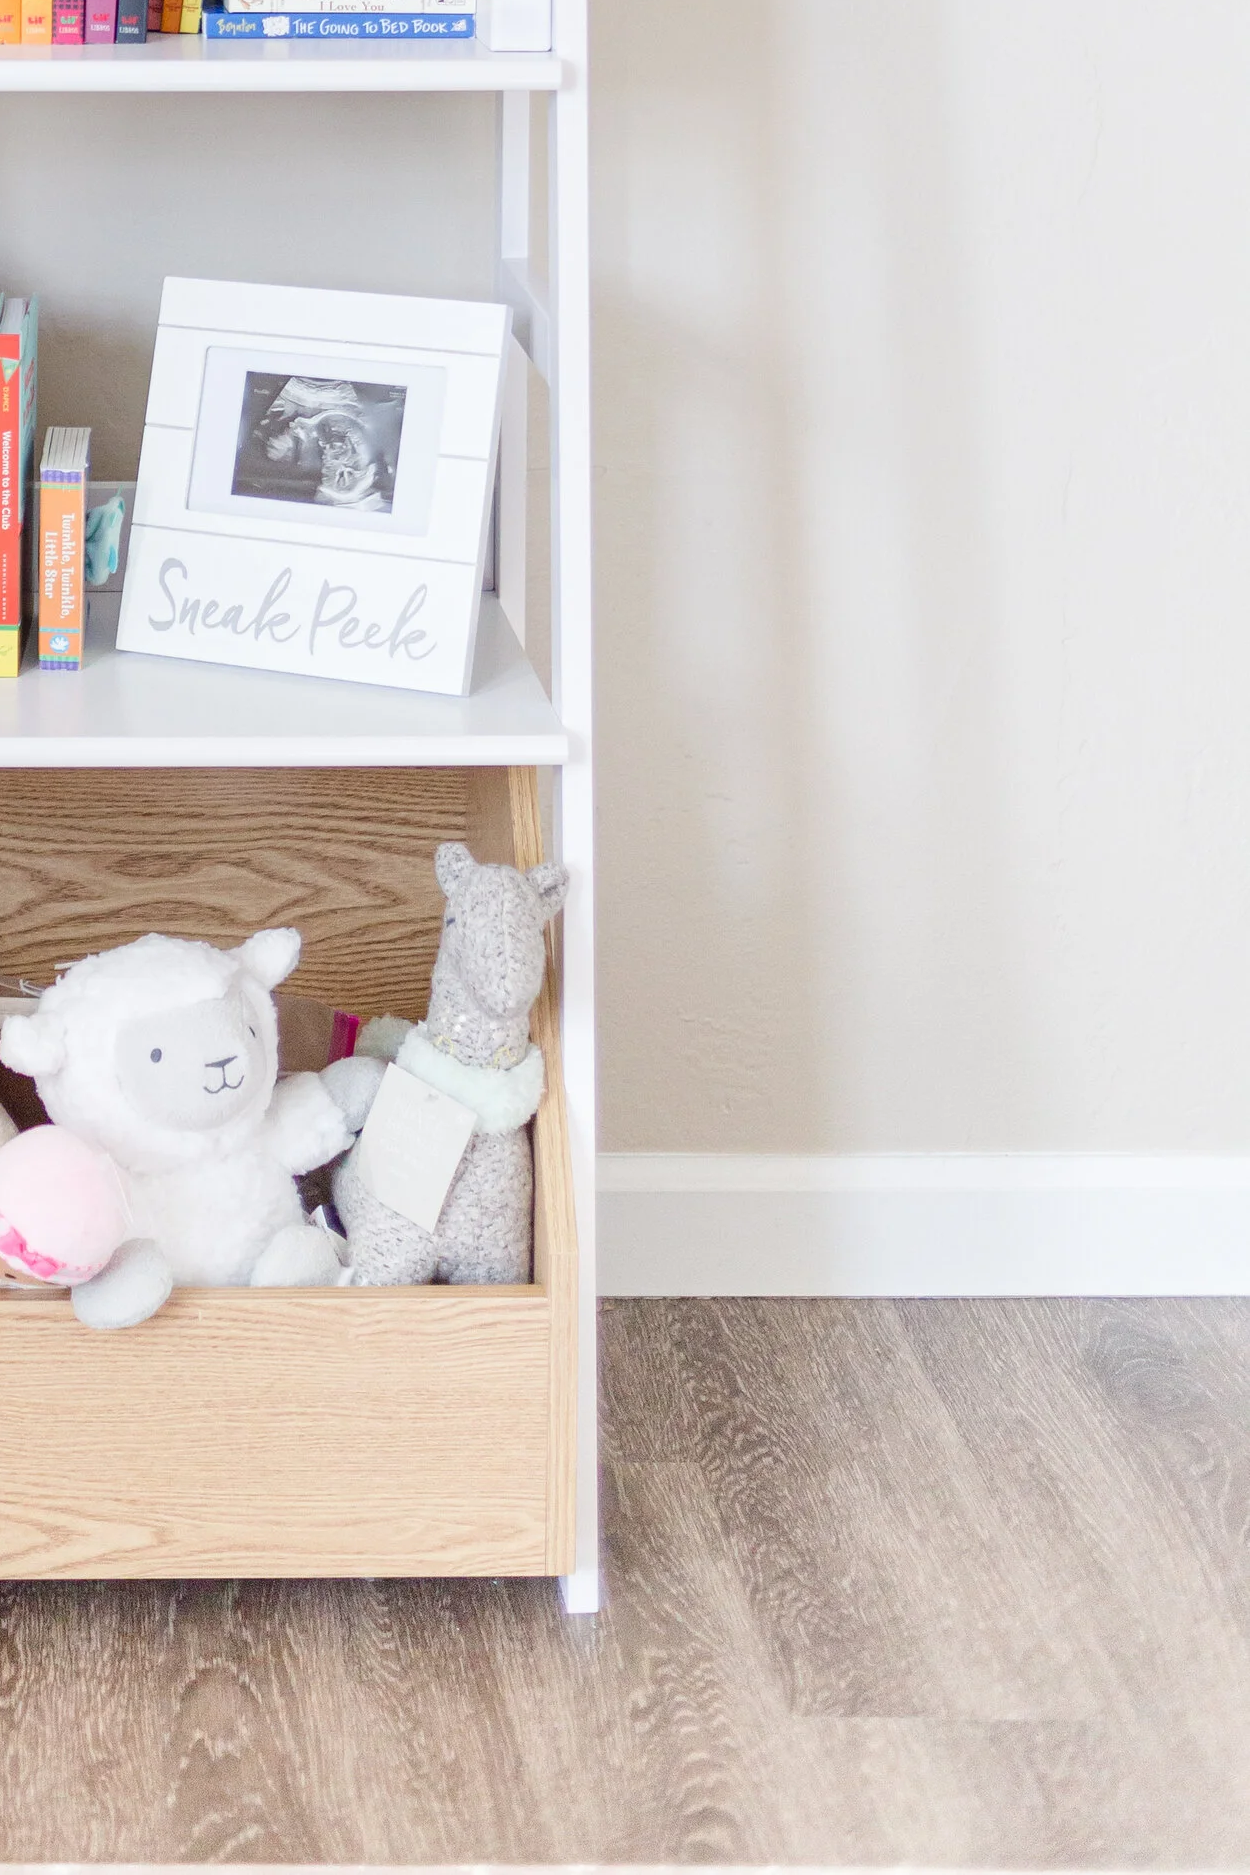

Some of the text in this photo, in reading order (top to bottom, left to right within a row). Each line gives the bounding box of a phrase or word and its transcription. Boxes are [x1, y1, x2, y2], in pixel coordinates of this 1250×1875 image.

[216, 17, 256, 36] Boynton
[292, 18, 448, 36] THE GOING TO BED BOOK
[329, 1, 357, 11] Love
[361, 1, 385, 11] You
[1, 430, 12, 530] Welcome to the Club
[44, 532, 58, 600] Little Star
[60, 512, 76, 619] Twinkle, Twinkle,
[148, 557, 438, 661] Sneak Peek
